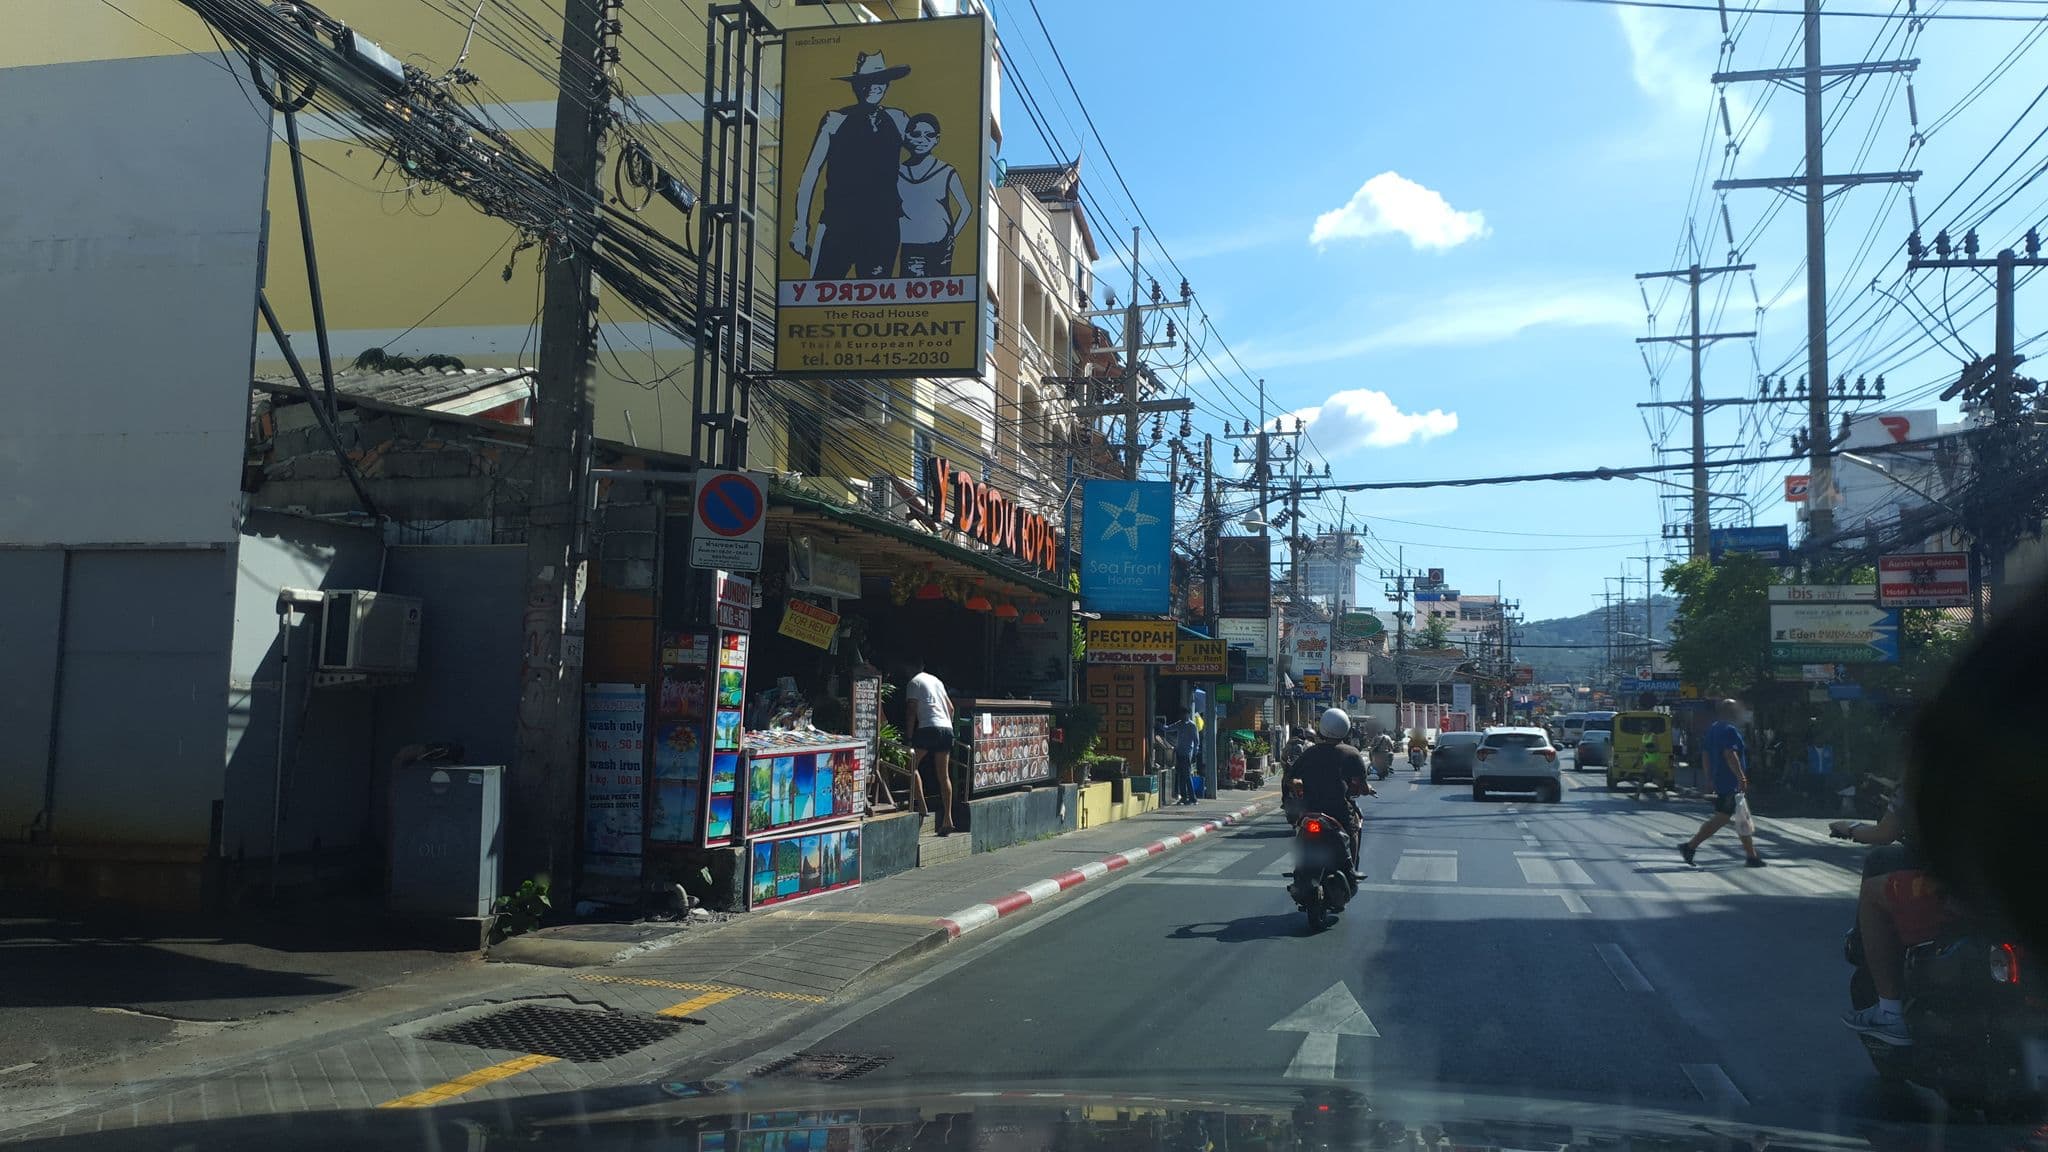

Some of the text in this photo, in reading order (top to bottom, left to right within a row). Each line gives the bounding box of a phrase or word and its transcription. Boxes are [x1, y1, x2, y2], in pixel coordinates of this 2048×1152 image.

[792, 283, 807, 302] У
[906, 279, 964, 299] ЮРЫ
[824, 308, 929, 320] The Road House
[788, 320, 966, 339] RESTOURANT
[847, 340, 914, 350] European
[918, 339, 953, 348] Food
[802, 351, 949, 367] tel. 081-415-2030
[1089, 560, 1161, 576] Sea Front
[1108, 575, 1144, 585] Home
[1788, 586, 1812, 599] ibis
[809, 621, 833, 635] RENT
[1090, 630, 1174, 644] РЕСТОРАН
[1194, 644, 1222, 655] INN
[1638, 681, 1681, 690] PHARMA
[589, 720, 642, 734] wash only
[589, 759, 617, 771] wash
